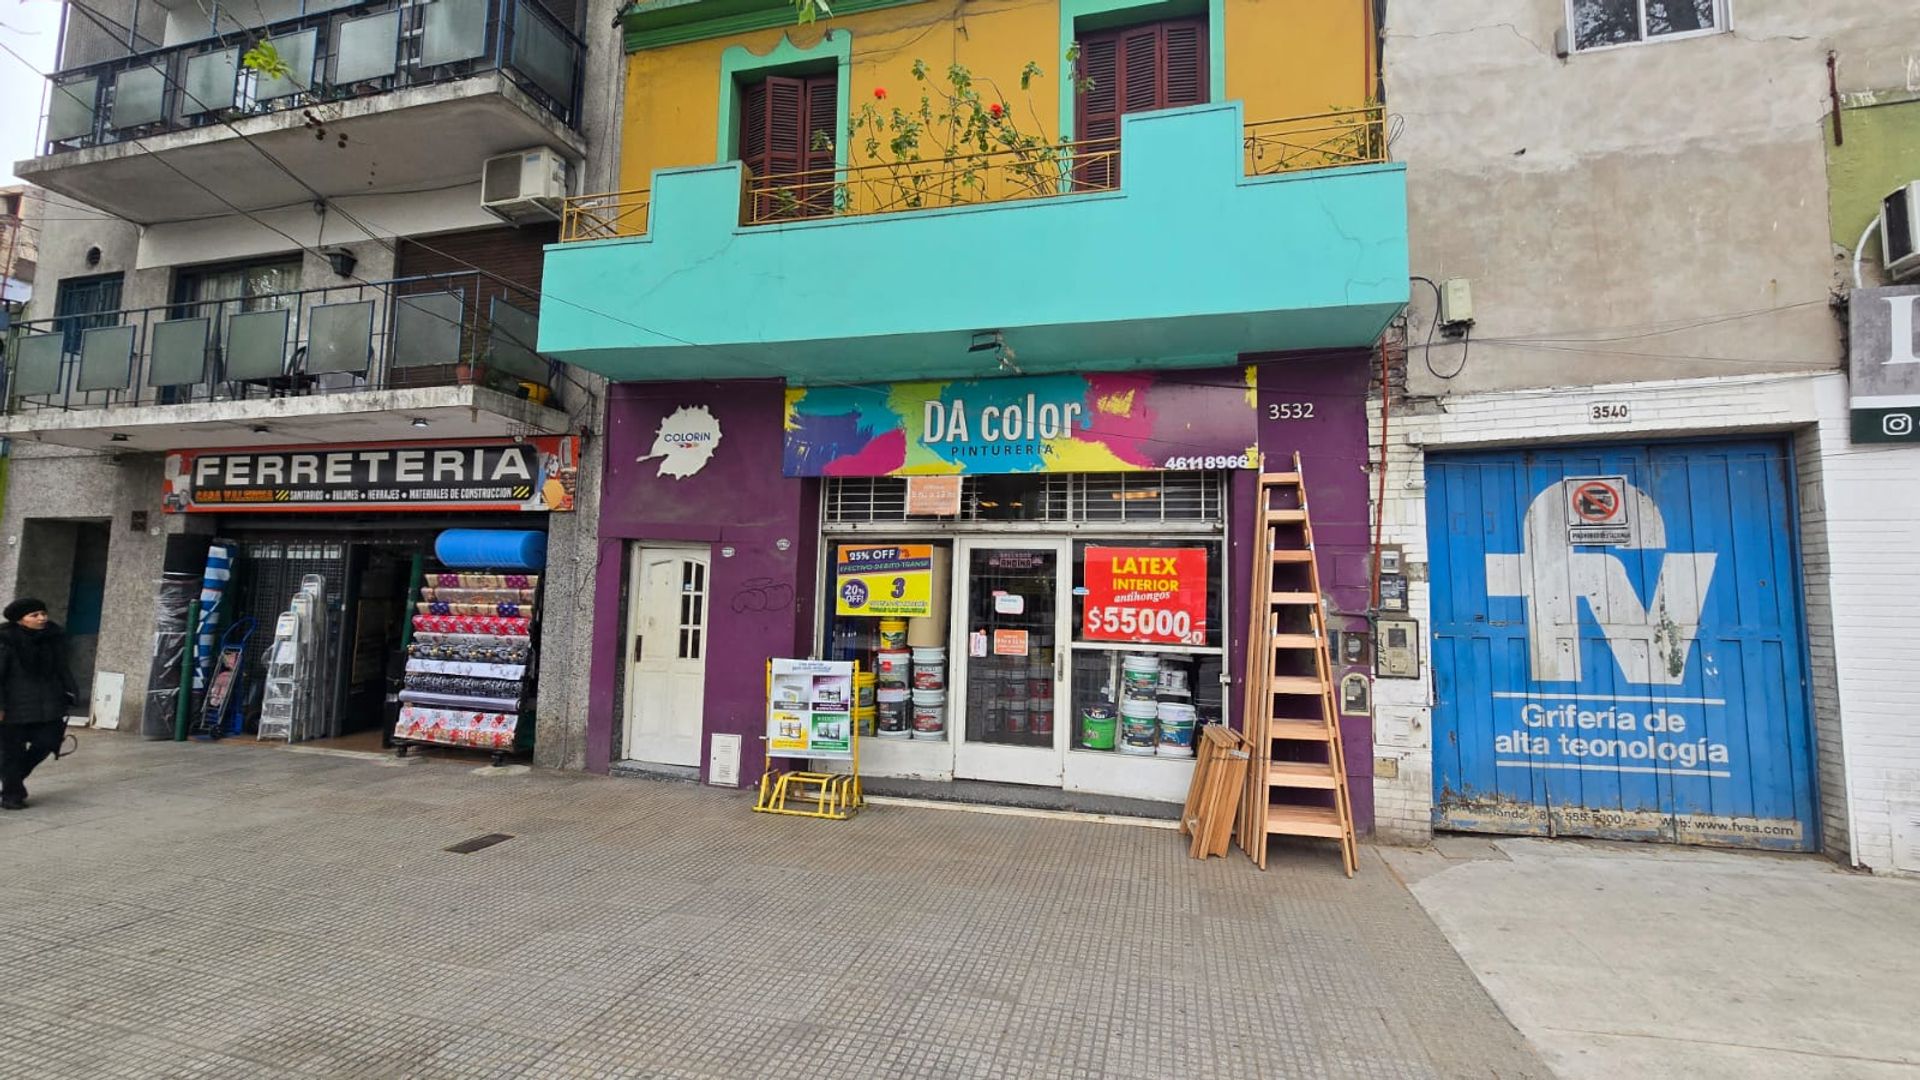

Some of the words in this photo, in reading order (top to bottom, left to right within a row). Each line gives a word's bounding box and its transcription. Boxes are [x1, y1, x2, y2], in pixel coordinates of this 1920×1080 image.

[923, 398, 968, 444] DA
[980, 392, 1082, 443] color
[1269, 402, 1315, 420] 3532
[1592, 405, 1627, 419] 3540
[664, 432, 711, 443] COLORIN
[950, 443, 1054, 457] PINTURERÍA
[195, 447, 532, 486] FERRETERIA
[1164, 454, 1249, 471] 46118966
[290, 490, 324, 501] SANITARIOS
[409, 488, 448, 500] MATERIALES
[450, 488, 459, 499] DE
[461, 487, 512, 499] CONSTRUCCION
[849, 551, 869, 561] 25%
[873, 549, 896, 560] OFF
[1112, 556, 1178, 576] LATEX
[844, 584, 866, 596] 20%
[890, 577, 906, 599] 3
[1112, 577, 1180, 592] INTERIOR
[846, 594, 864, 604] OFF!
[1113, 590, 1171, 603] antihongos
[1087, 606, 1191, 638] $55000
[1520, 703, 1636, 729] Grifería
[1643, 708, 1686, 733] de
[1495, 730, 1550, 755] alta
[1660, 816, 1691, 829] Wb:
[1695, 820, 1794, 836] www.fvsa.com
